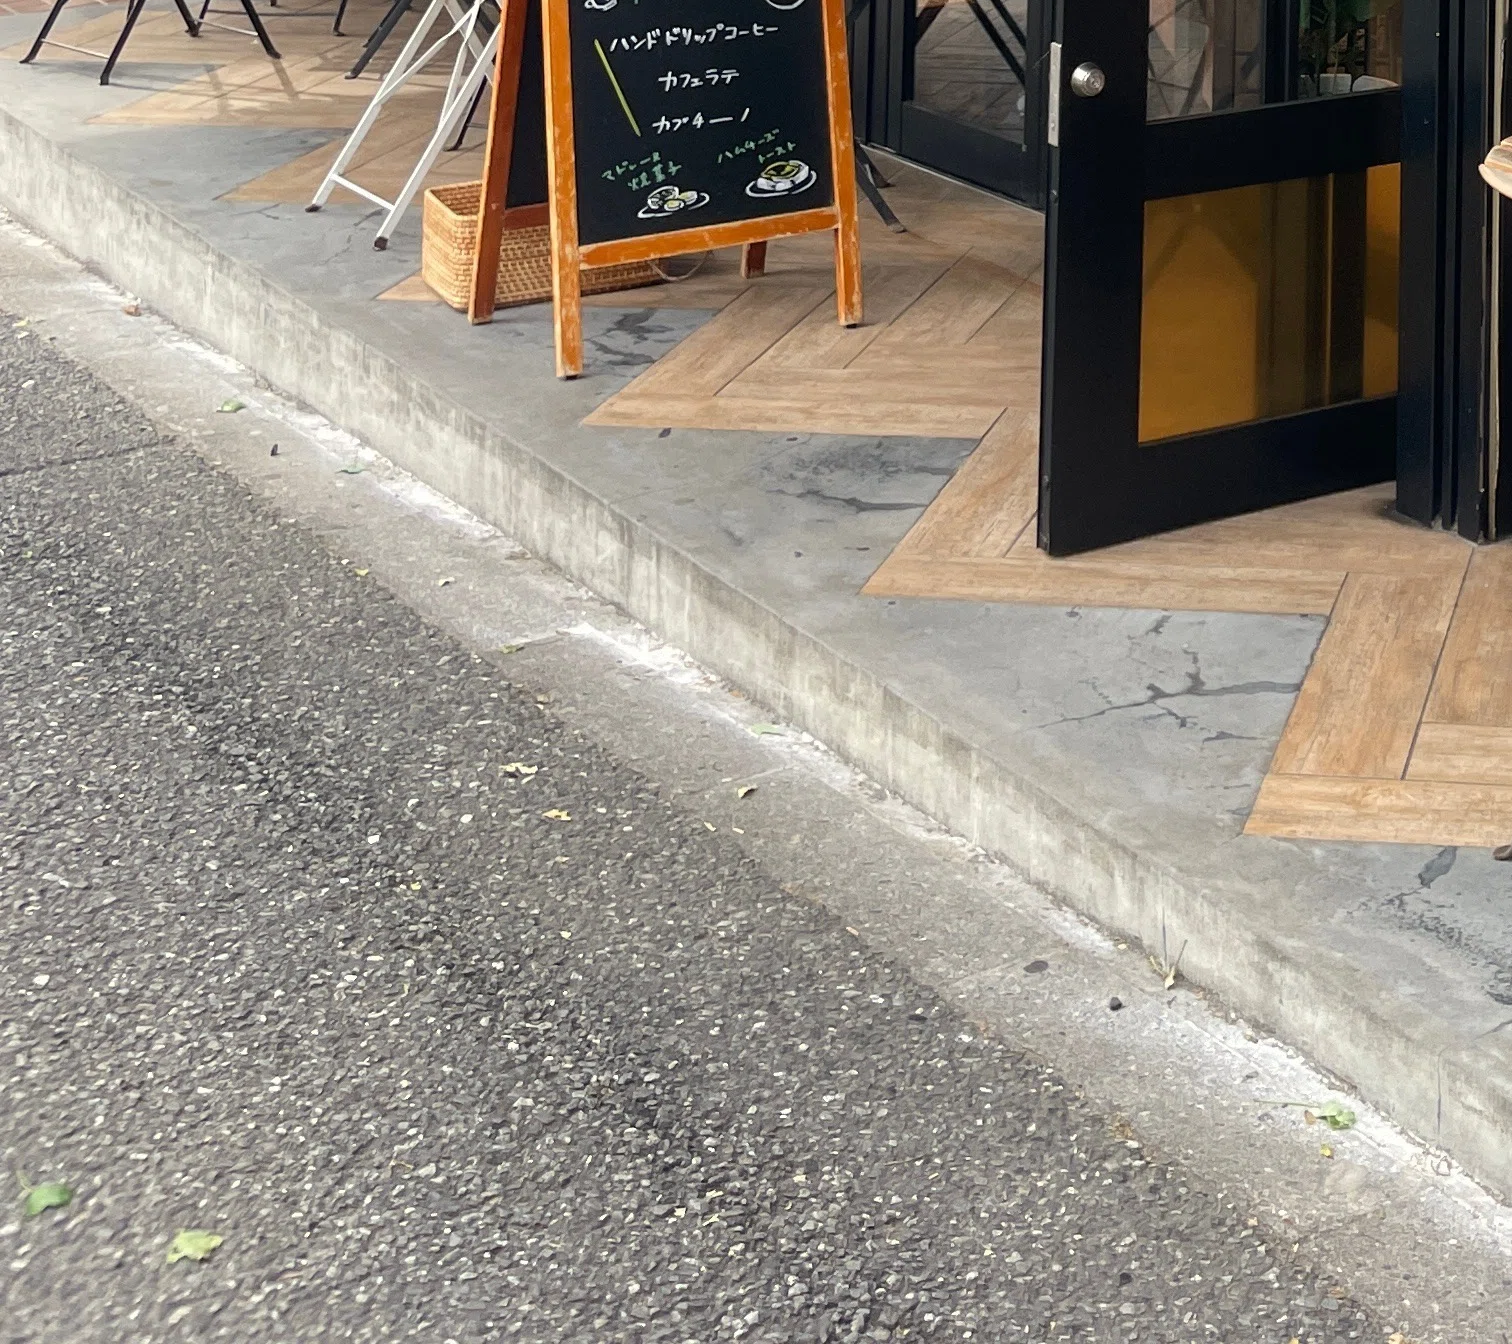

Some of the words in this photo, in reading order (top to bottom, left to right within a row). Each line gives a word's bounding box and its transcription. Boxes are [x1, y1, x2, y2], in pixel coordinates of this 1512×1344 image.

[658, 69, 740, 93] カフェラテ
